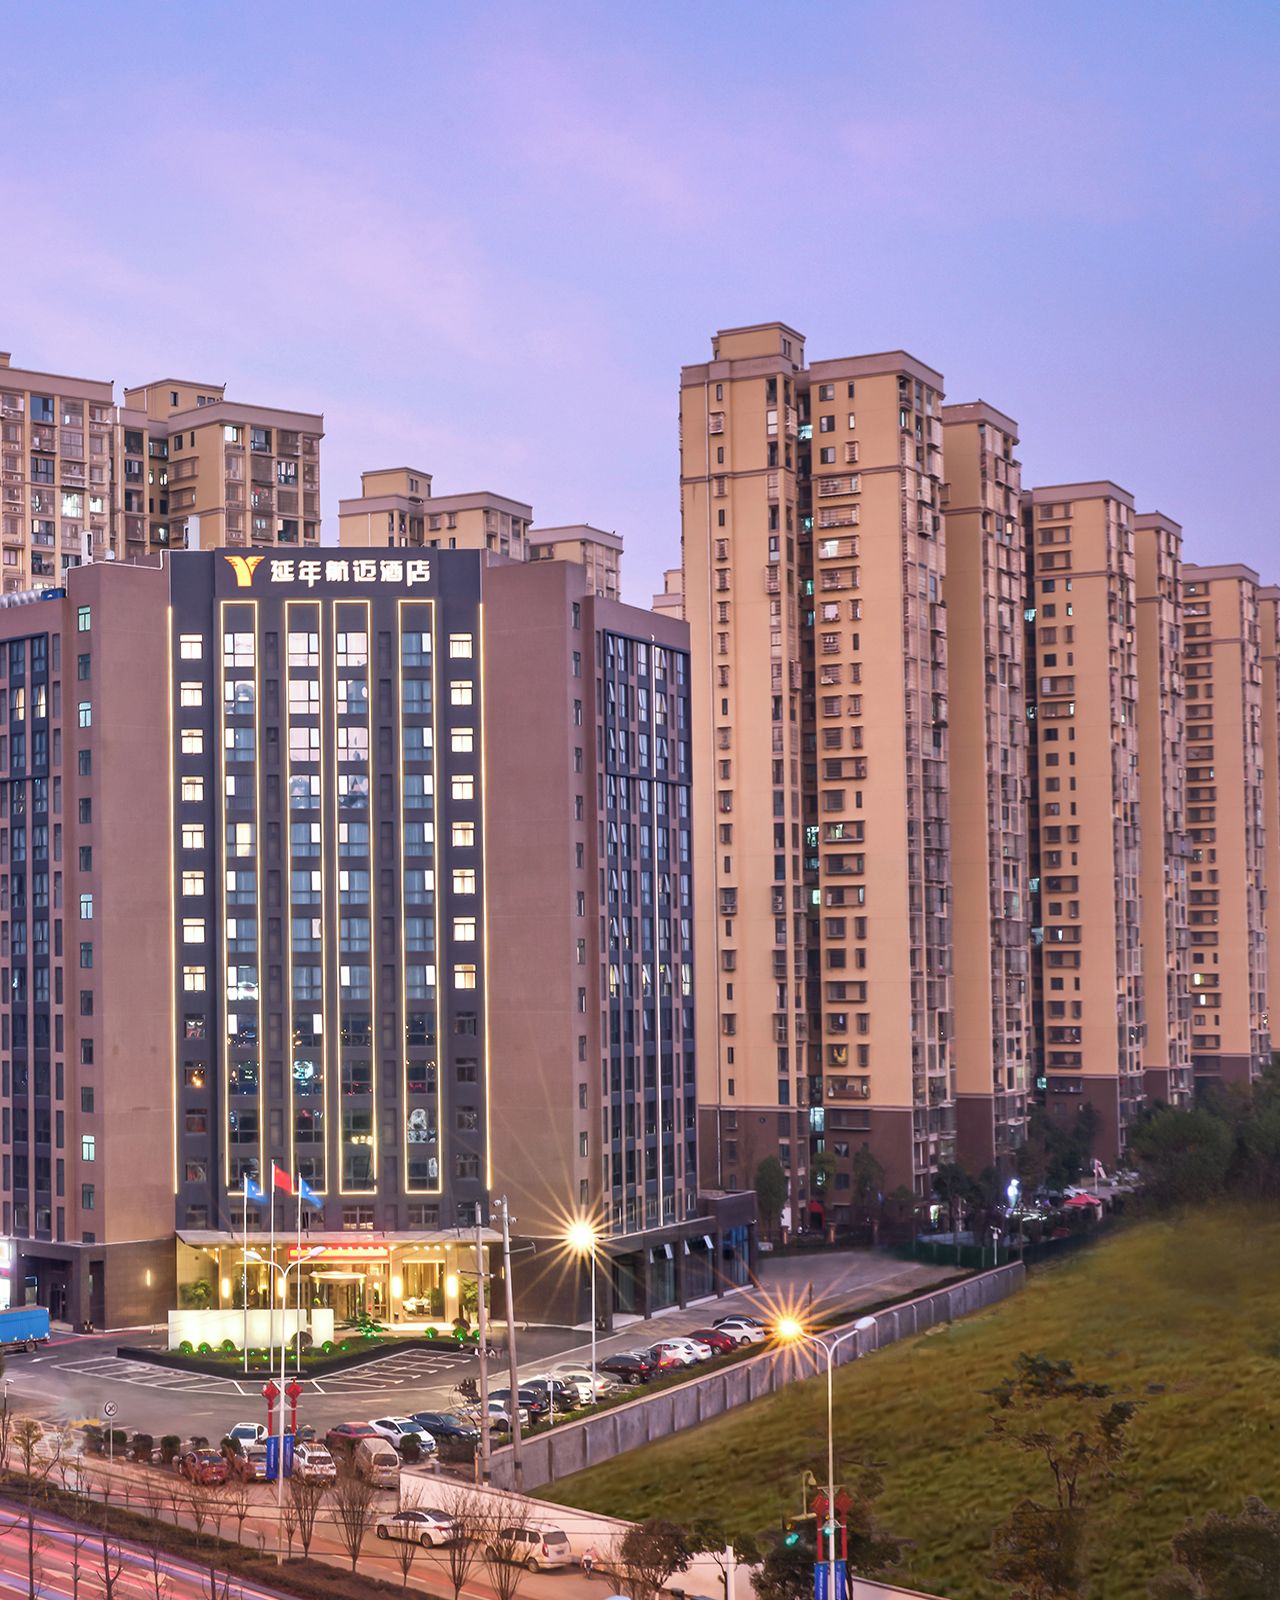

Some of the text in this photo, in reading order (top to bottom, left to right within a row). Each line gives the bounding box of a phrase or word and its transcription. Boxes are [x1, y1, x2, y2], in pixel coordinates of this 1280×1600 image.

[270, 560, 430, 588] 延年航迈酒店
